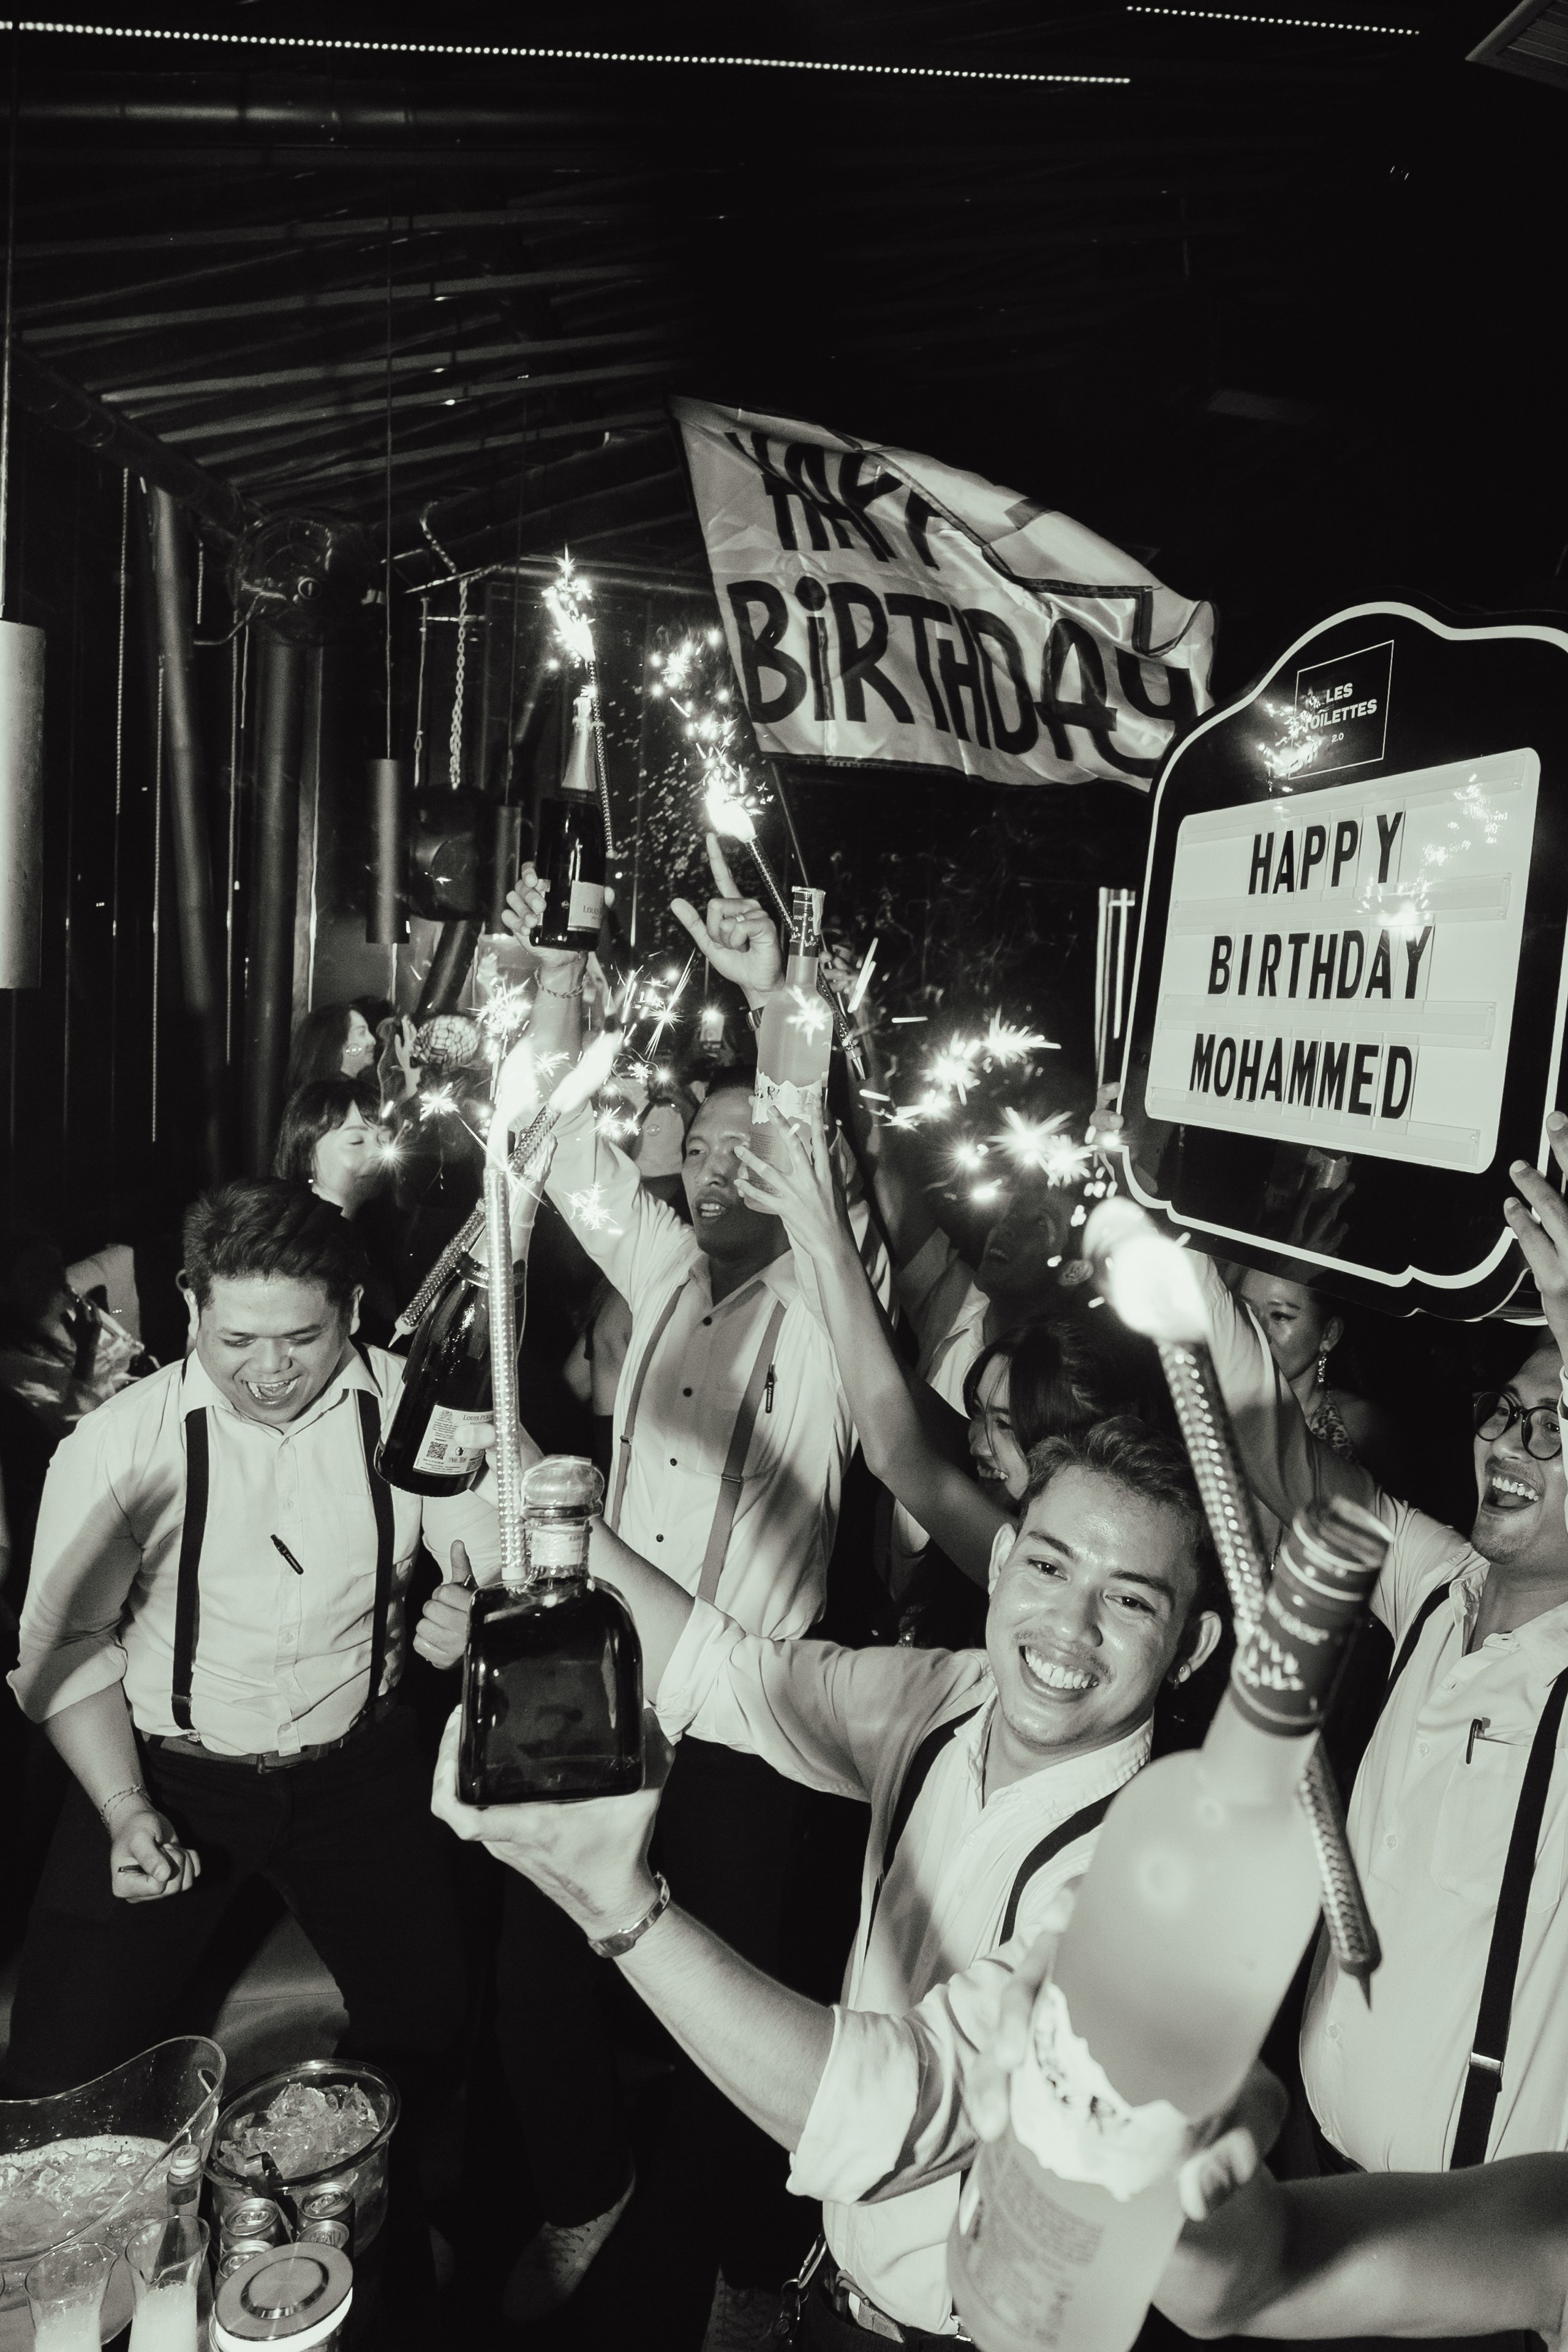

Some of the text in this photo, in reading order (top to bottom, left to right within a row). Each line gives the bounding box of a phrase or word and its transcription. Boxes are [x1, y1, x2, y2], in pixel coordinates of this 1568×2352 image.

[1325, 682, 1353, 704] LES
[1331, 732, 1344, 743] 2.0
[1248, 812, 1404, 895] HAPPY
[1208, 926, 1433, 1000] BIRTHDAY
[1189, 1033, 1412, 1120] MOHAMMED
